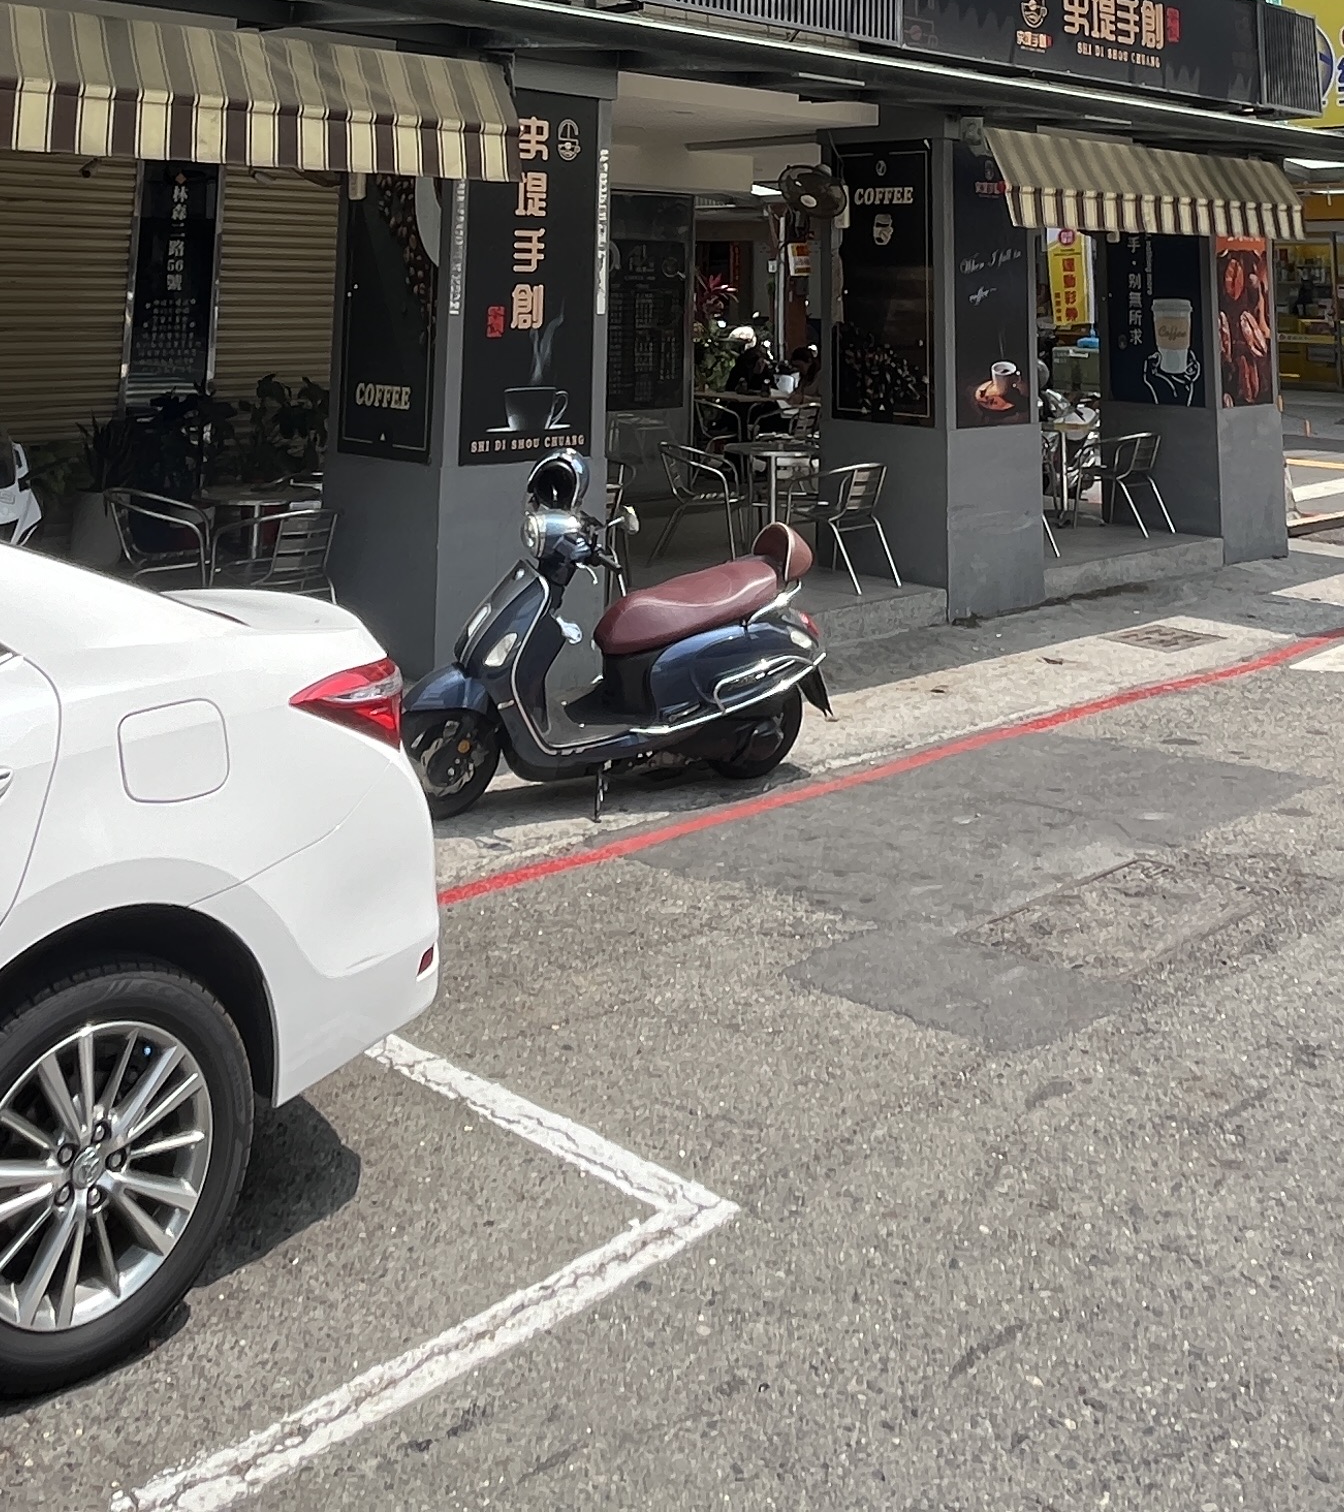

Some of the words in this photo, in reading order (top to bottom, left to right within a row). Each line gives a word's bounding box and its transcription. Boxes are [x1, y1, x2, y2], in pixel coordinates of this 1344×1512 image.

[1077, 41, 1092, 55] SHI
[1095, 44, 1105, 58] DI
[1107, 48, 1129, 62] SHOU
[1131, 52, 1161, 68] CHUANG
[854, 187, 914, 206] COFFEE
[1158, 326, 1187, 341] Coffee
[355, 382, 411, 411] COFFEE
[471, 441, 490, 453] SHI
[495, 440, 506, 450] DI
[511, 438, 540, 449] SHOU
[545, 435, 584, 447] CHUANG
